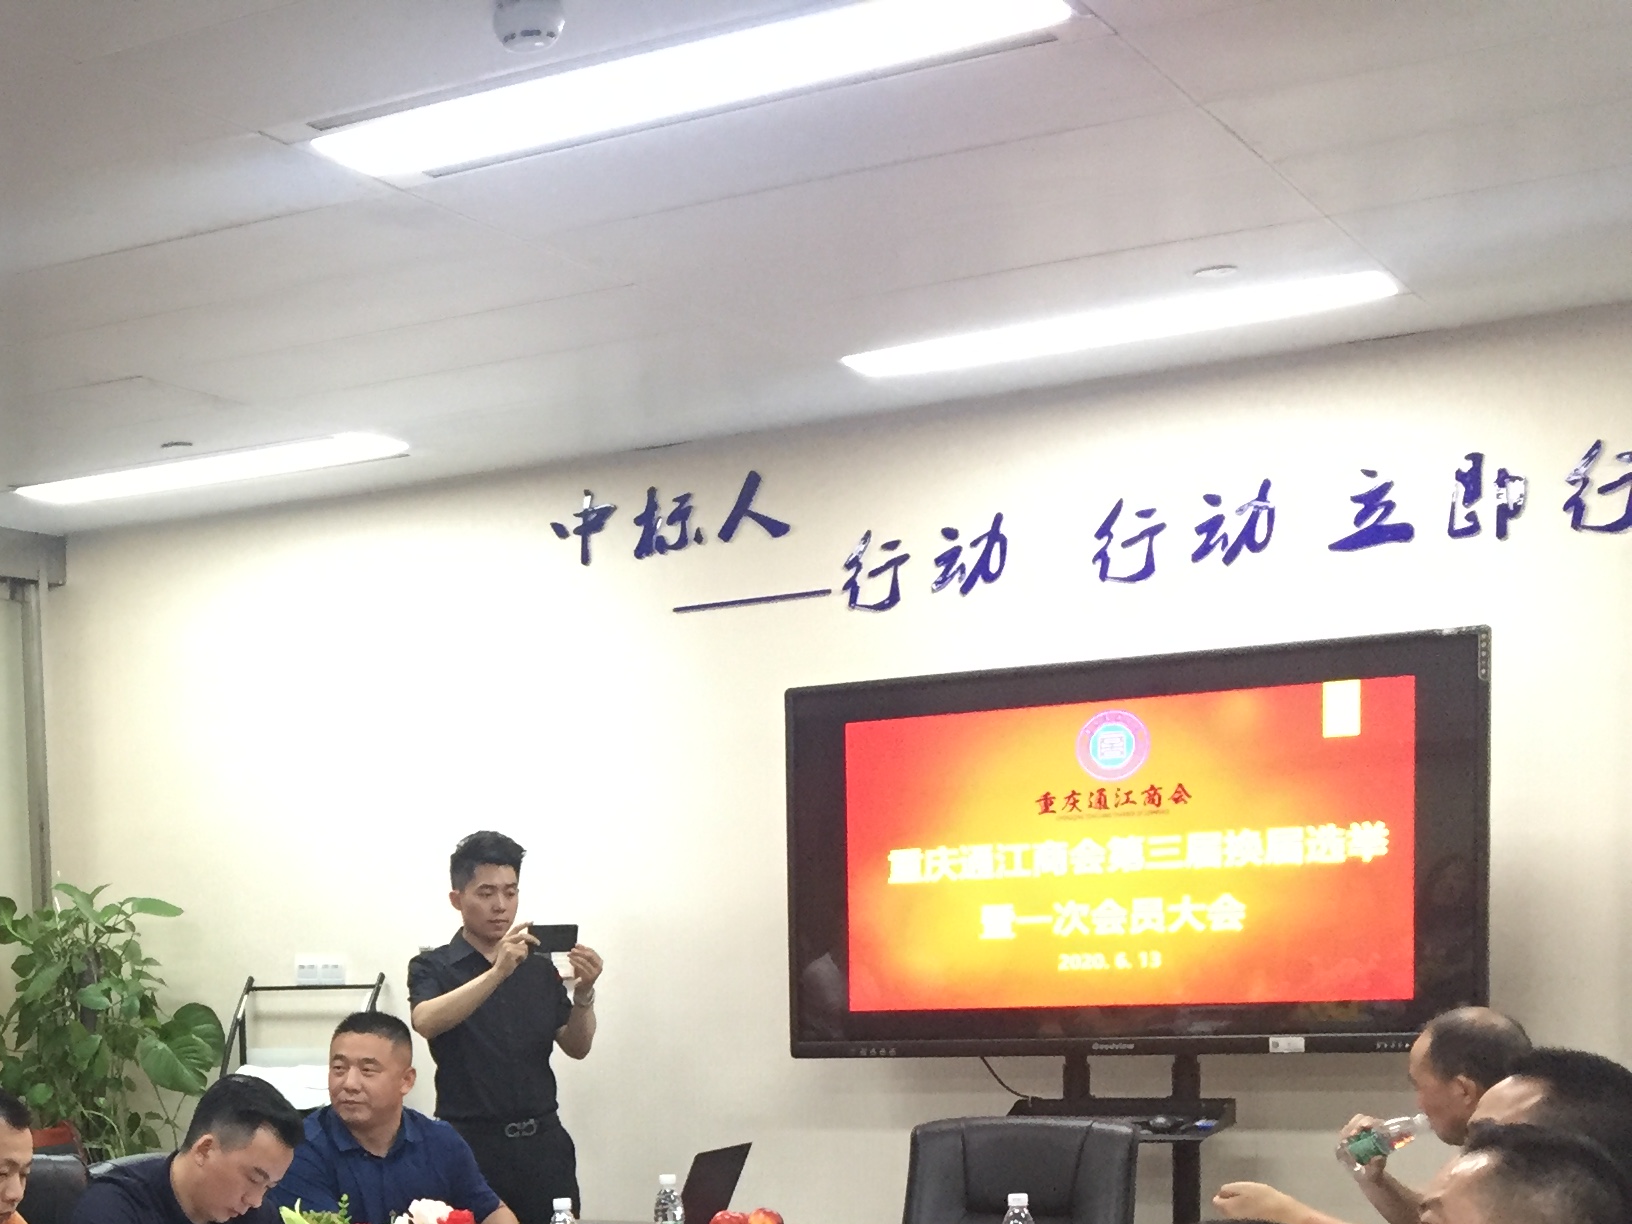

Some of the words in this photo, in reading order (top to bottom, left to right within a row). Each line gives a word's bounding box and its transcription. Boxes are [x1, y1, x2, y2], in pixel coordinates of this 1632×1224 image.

[550, 470, 791, 567] 中标人
[1091, 478, 1275, 584] 行动
[1034, 782, 1193, 816] 重庆通江商会
[887, 820, 1390, 885] 重庆通江商会第三届换届选举
[1138, 950, 1163, 969] 13
